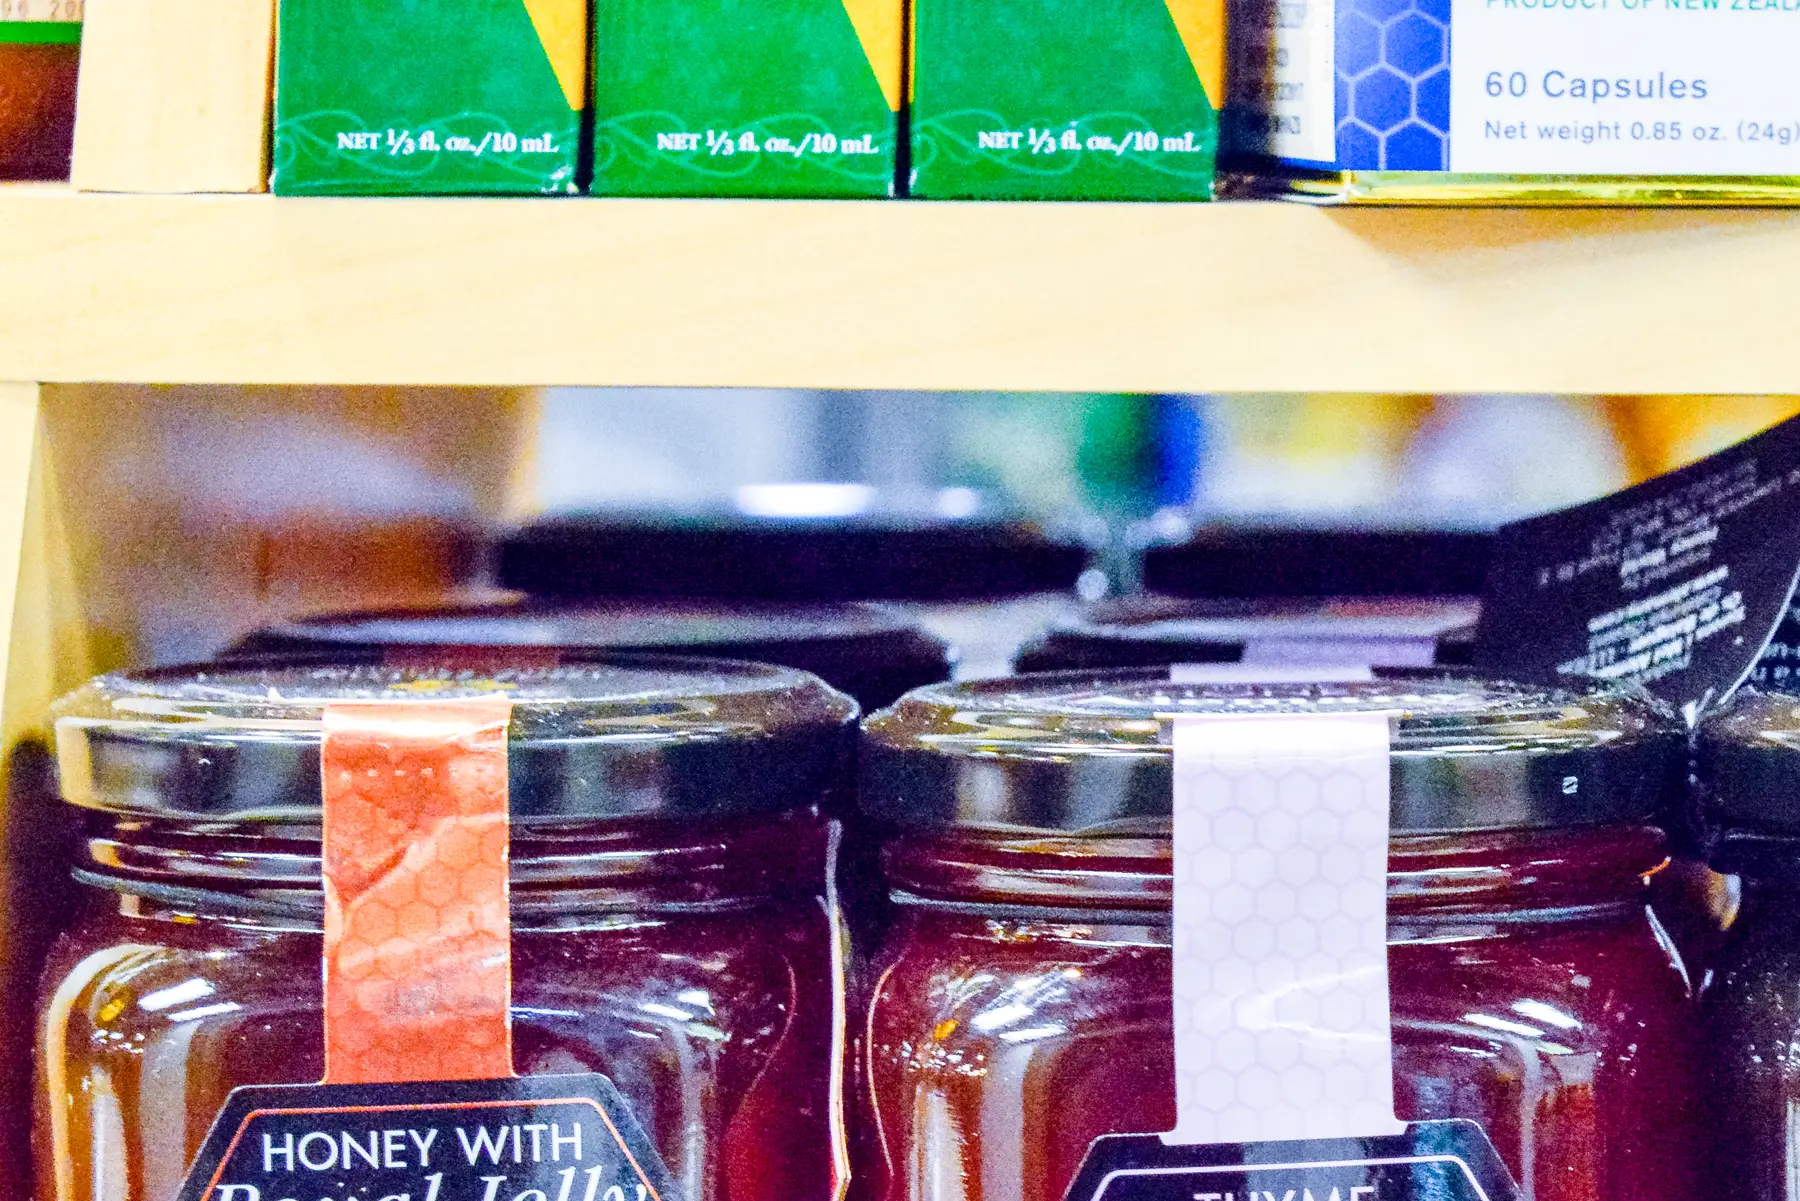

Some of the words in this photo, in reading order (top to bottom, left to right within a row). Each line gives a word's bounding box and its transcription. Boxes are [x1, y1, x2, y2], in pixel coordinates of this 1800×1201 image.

[1485, 71, 1528, 98] 60
[1541, 70, 1708, 104] Capsules
[337, 131, 382, 150] NET
[418, 130, 440, 151] fl.
[521, 133, 560, 153] mL
[656, 132, 702, 151] NET
[738, 131, 760, 152] fl.
[840, 134, 879, 154] mL
[978, 131, 1023, 150] NET
[1061, 129, 1082, 151] fl.
[1162, 131, 1201, 152] mL
[1485, 120, 1528, 141] Net
[1537, 120, 1621, 145] weight
[1631, 121, 1682, 142] 0.85
[1692, 124, 1727, 142] oz.
[263, 1128, 437, 1172] HONEY
[457, 1122, 582, 1167] WITH
